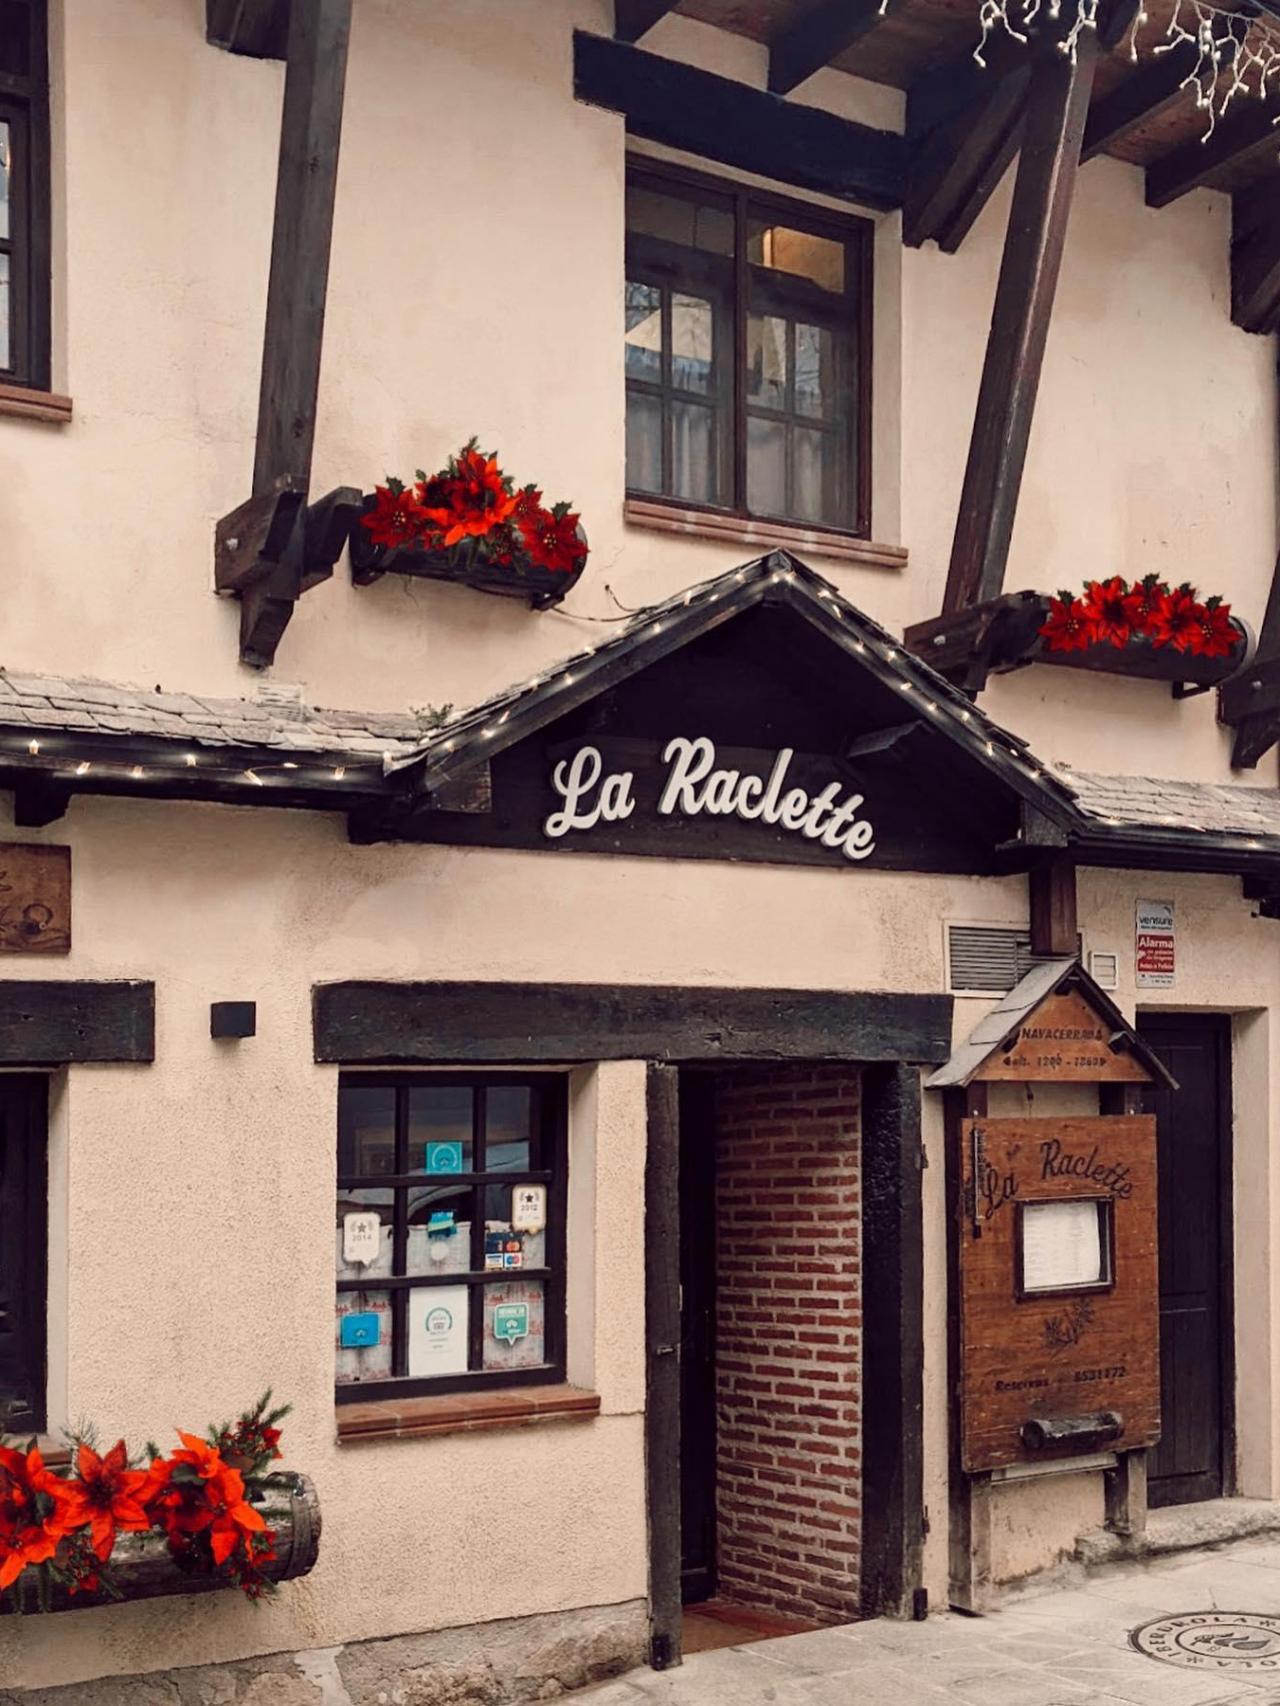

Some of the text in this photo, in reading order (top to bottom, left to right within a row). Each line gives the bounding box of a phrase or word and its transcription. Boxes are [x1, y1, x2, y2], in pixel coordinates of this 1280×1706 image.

[544, 736, 876, 860] La Raclette
[1139, 936, 1173, 948] Alarma
[1021, 1028, 1103, 1040] NAVACERRADA
[981, 1138, 1134, 1220] La Raclette
